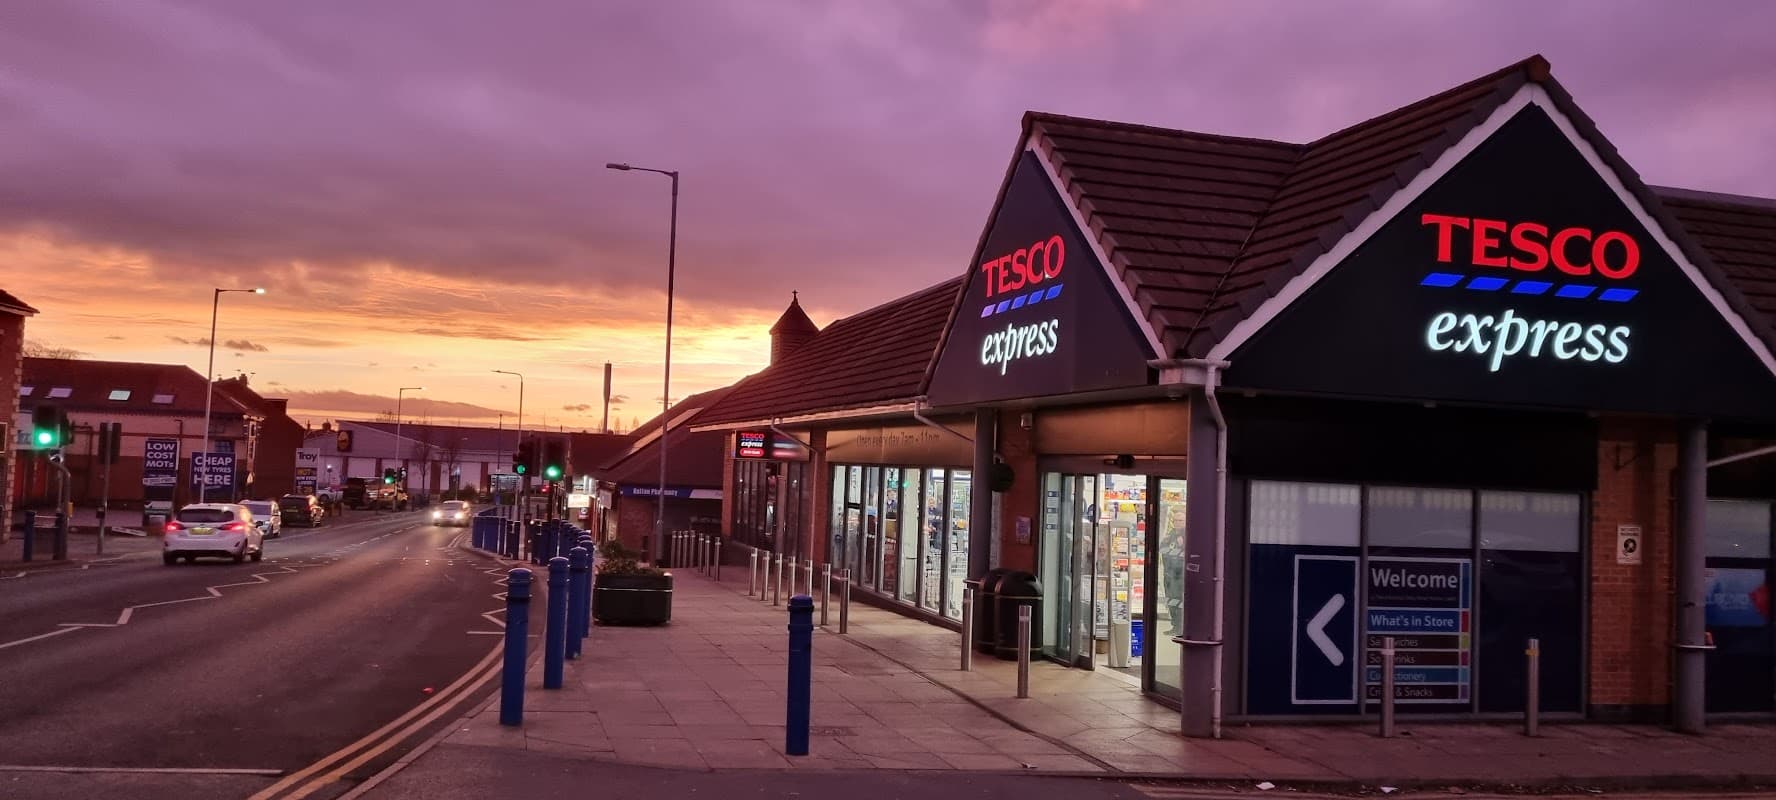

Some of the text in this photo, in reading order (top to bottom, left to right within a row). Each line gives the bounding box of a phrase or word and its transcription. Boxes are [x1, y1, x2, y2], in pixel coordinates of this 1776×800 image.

[1421, 213, 1640, 280] TESCO
[982, 235, 1066, 298] TESCO
[1426, 308, 1631, 372] express
[981, 318, 1060, 376] express
[147, 442, 176, 451] LOW
[147, 451, 175, 459] COST
[194, 456, 233, 466] CHEAP
[297, 452, 318, 463] Troy
[193, 475, 232, 485] HERE
[1371, 567, 1459, 589] Welcome
[1371, 614, 1455, 628] What's in Store
[1393, 654, 1418, 665] rinks
[1404, 687, 1433, 699] Snacks
